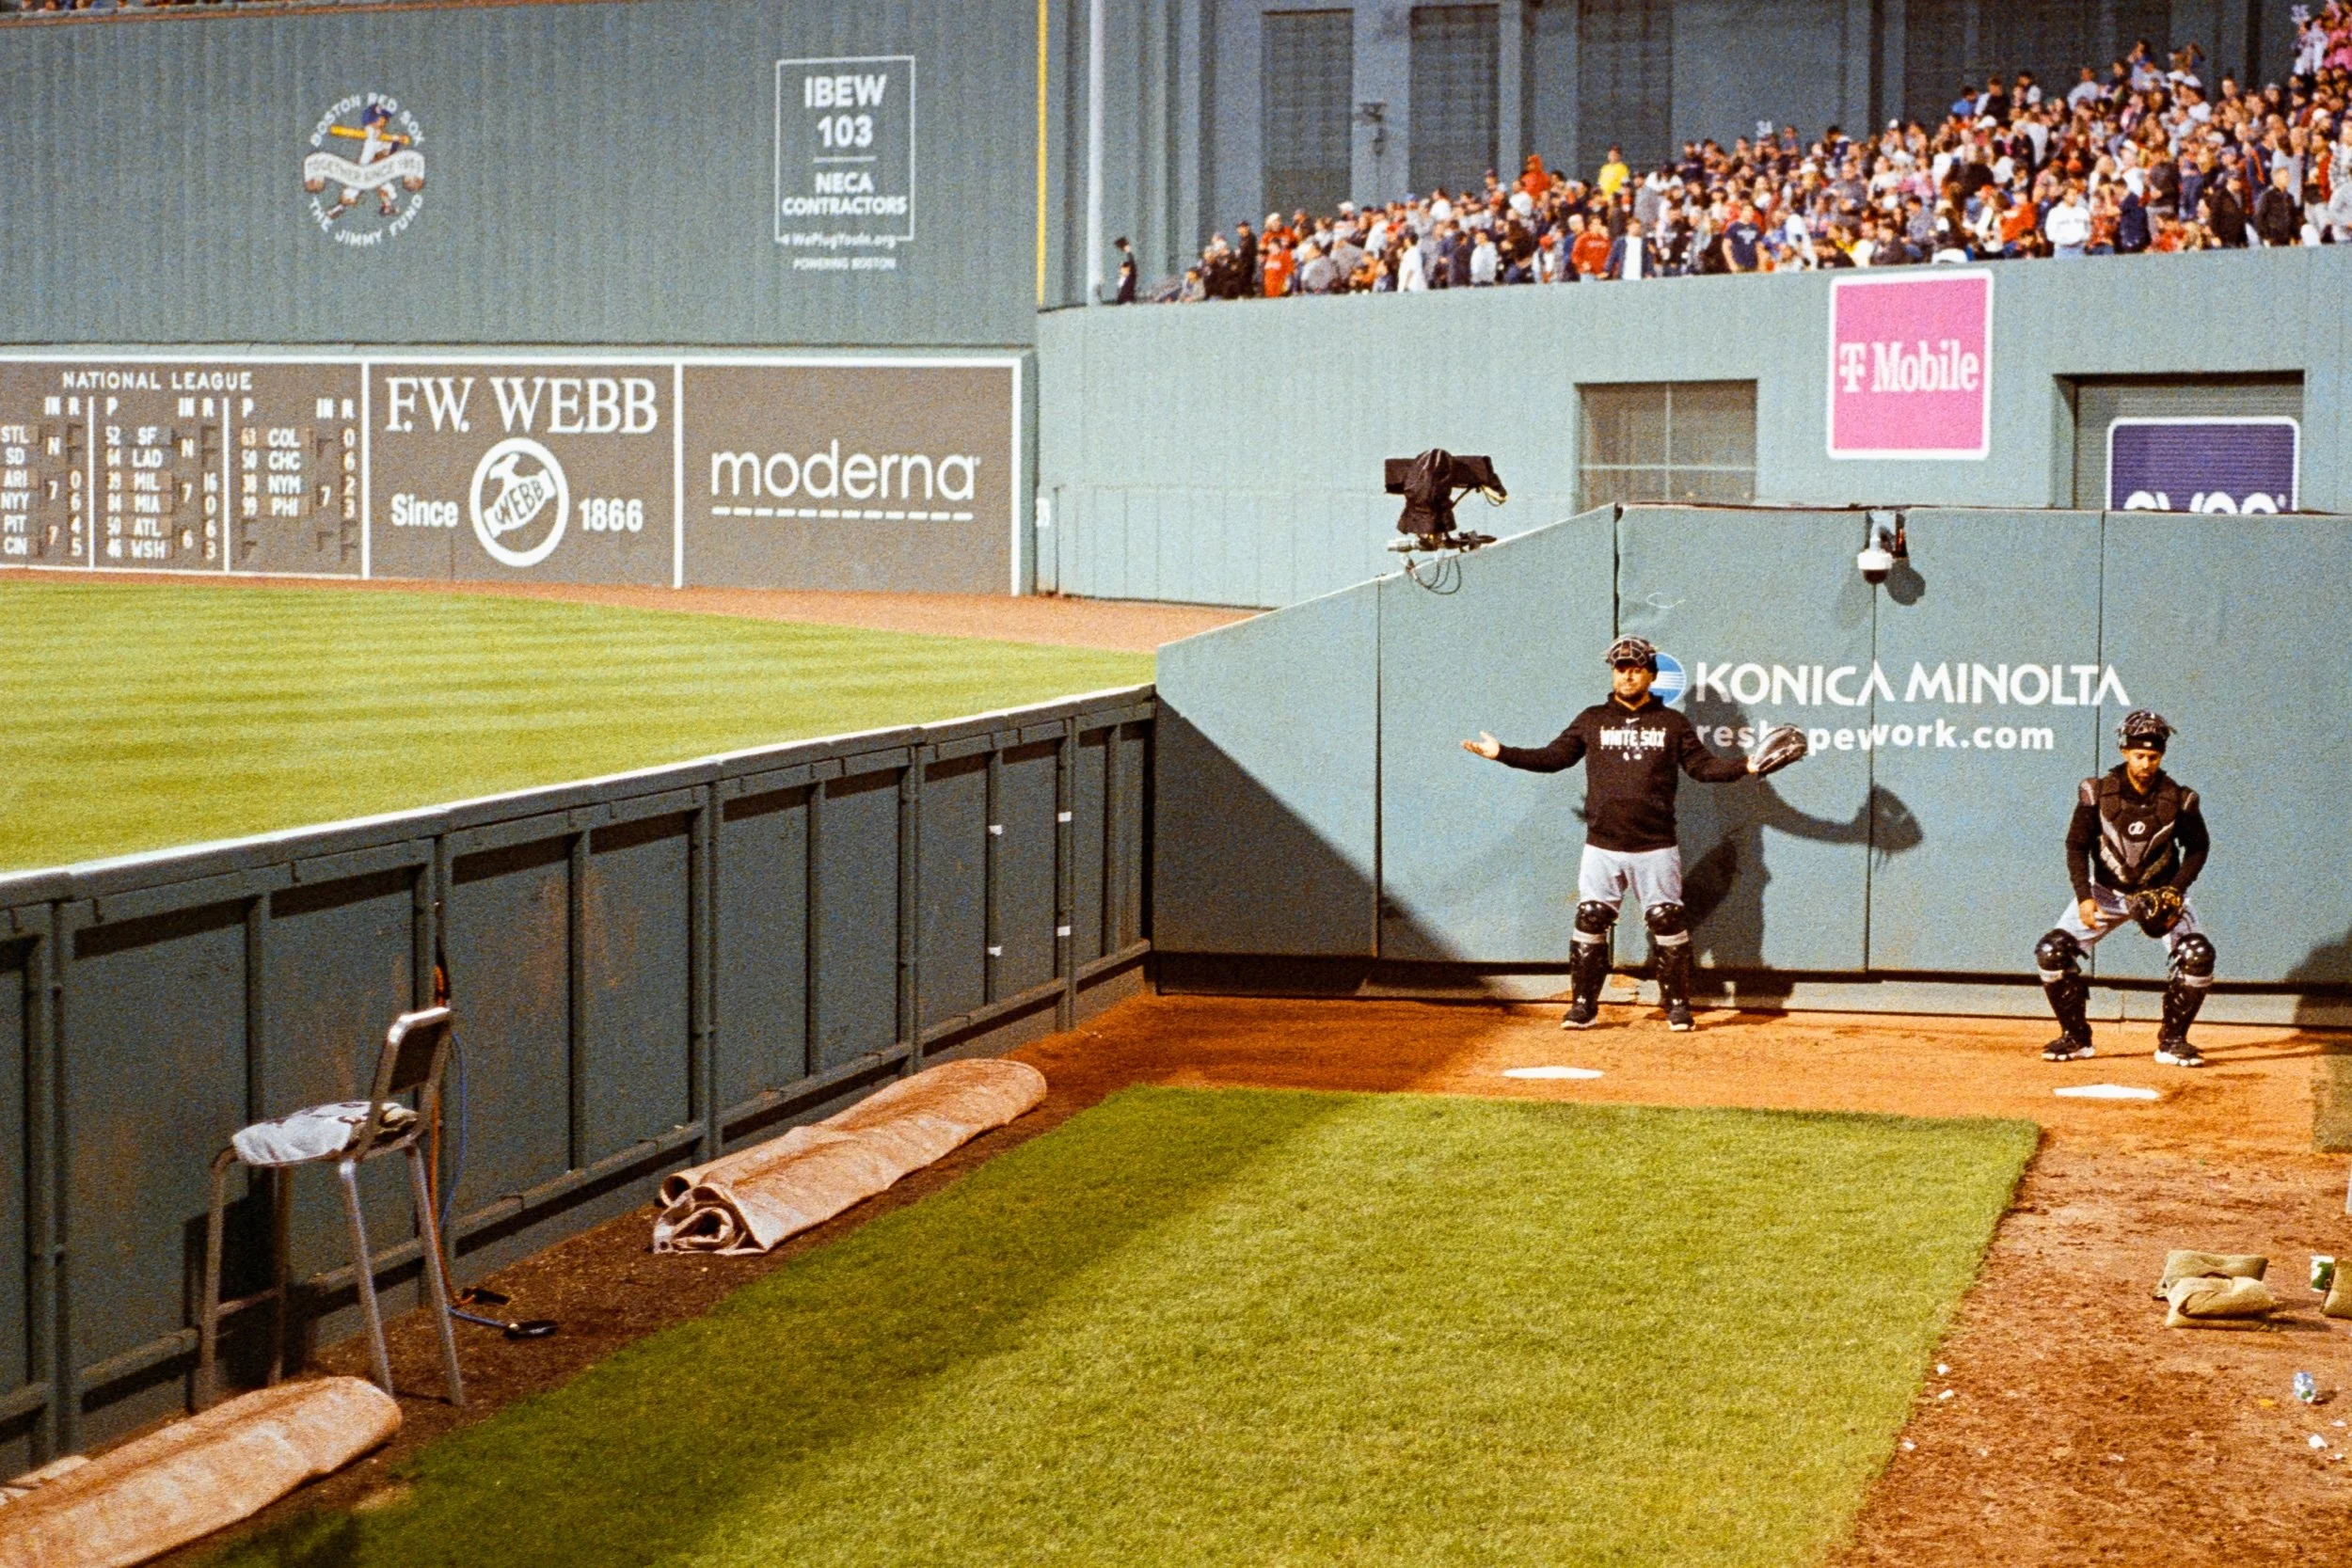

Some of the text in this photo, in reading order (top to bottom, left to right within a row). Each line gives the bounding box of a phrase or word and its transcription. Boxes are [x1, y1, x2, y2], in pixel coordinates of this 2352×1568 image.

[804, 73, 887, 108] IBEW
[310, 91, 425, 147] BOSTON RED SOX
[817, 114, 874, 148] 103
[815, 172, 875, 194] NECA
[782, 196, 908, 216] CONTRACTORS
[334, 229, 384, 247] JIMMY
[389, 194, 423, 237] FUND
[1870, 339, 1979, 392] Mobile
[62, 372, 253, 391] NATIONAL LEAGUE
[44, 396, 80, 417] IN R
[105, 396, 215, 419] P IN R
[241, 397, 255, 419] P
[385, 376, 659, 434] F.W. WEBB
[0, 425, 30, 444] STL
[137, 426, 158, 446] SF
[267, 427, 301, 448] COL
[342, 427, 356, 449] 0
[5, 447, 25, 466] SD
[132, 448, 164, 468] LAD
[181, 437, 195, 458] N
[267, 450, 301, 470] CHC
[710, 437, 978, 501] moderna
[3, 469, 82, 489] ARI 0
[134, 471, 161, 492] MIL
[267, 473, 301, 495] NYM
[343, 474, 356, 497] 2
[0, 491, 30, 510] NYY
[48, 480, 58, 500] 7
[181, 482, 193, 503] 7
[320, 484, 331, 508] 7
[134, 494, 160, 514] MIA
[204, 494, 217, 515] 0
[271, 496, 299, 517] PHI
[343, 498, 356, 519] 3
[495, 480, 545, 524] WEBB
[3, 514, 27, 533] PIT
[390, 493, 644, 533] Since 1866
[48, 525, 59, 546] 7
[134, 517, 162, 538] ATL
[3, 536, 83, 557] CIN 5
[130, 539, 167, 560] WSH
[204, 540, 217, 561] 3
[1695, 660, 2131, 707] KONICA MINOLTA
[1600, 729, 1666, 748] WHITE SOX
[1695, 719, 2055, 757] reshpework.com
